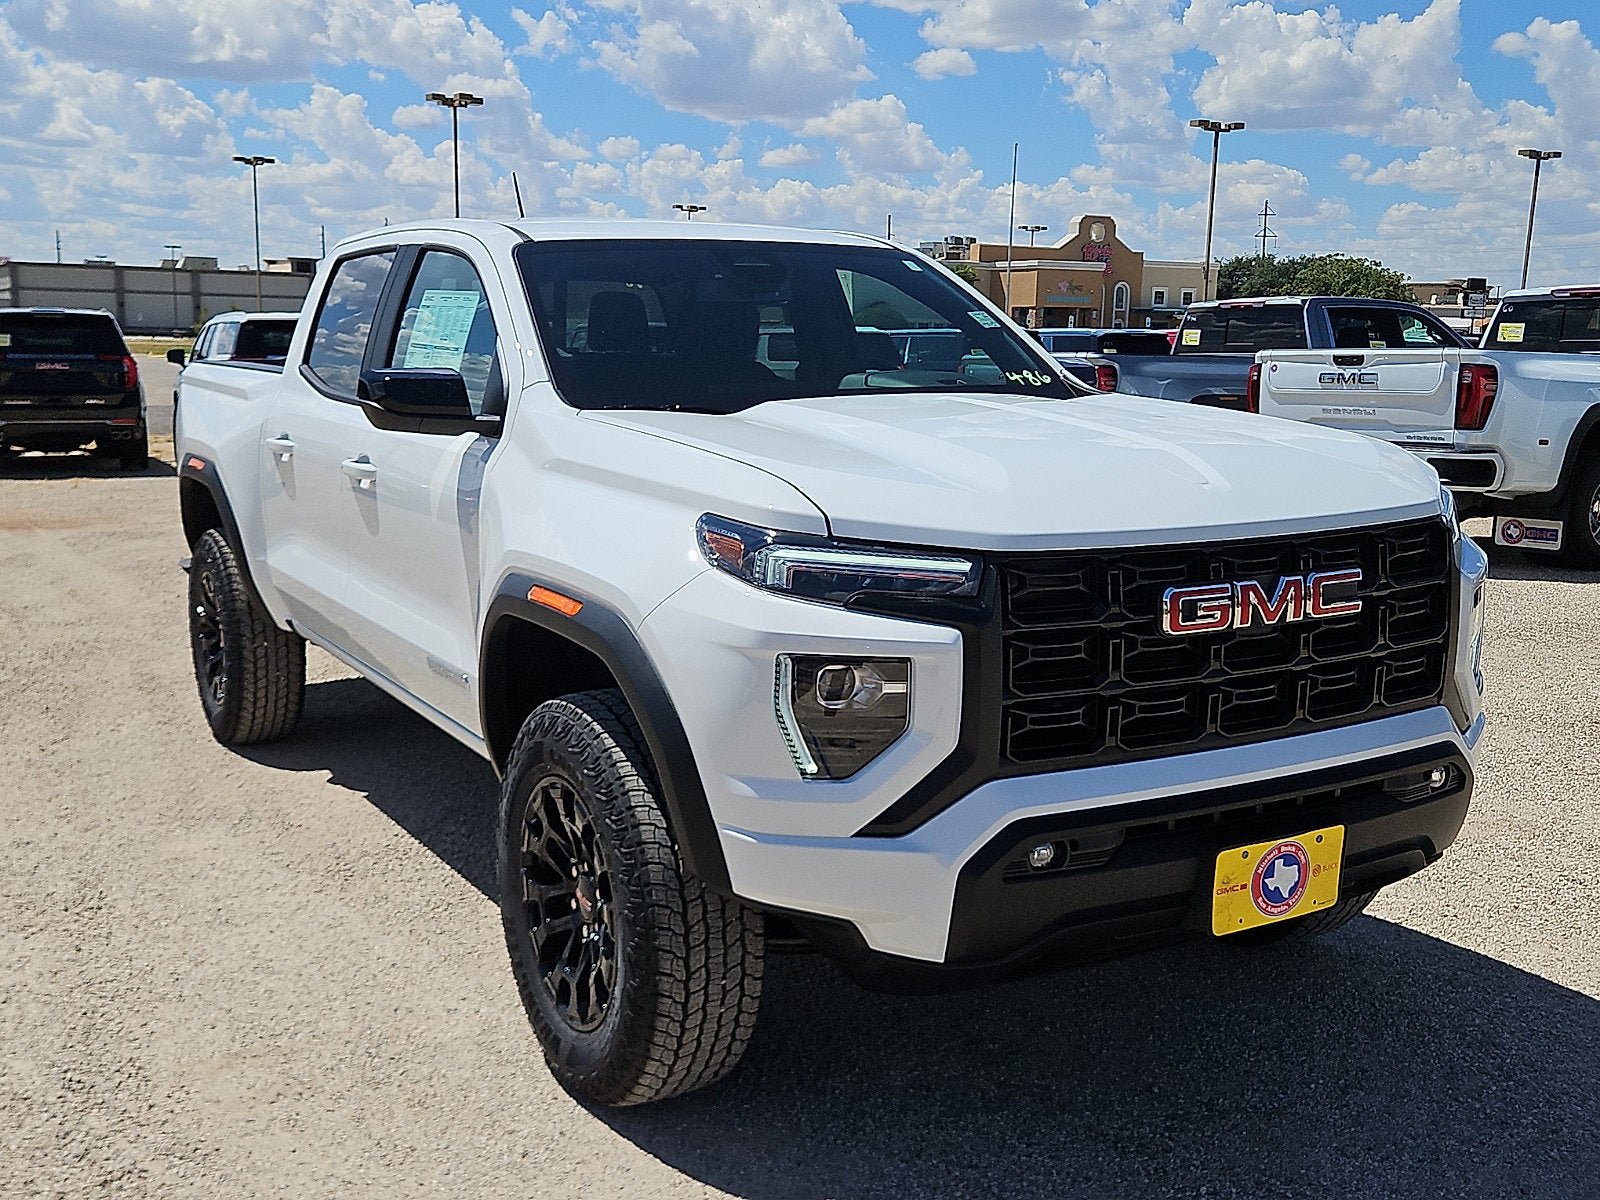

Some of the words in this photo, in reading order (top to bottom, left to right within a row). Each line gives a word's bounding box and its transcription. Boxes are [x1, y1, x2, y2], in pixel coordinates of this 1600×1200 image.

[35, 362, 70, 370] GMC
[1005, 369, 1052, 386] 486
[1318, 372, 1379, 386] GMC
[1526, 529, 1557, 539] GMC
[1162, 567, 1363, 635] GMC
[1216, 885, 1240, 896] GMC
